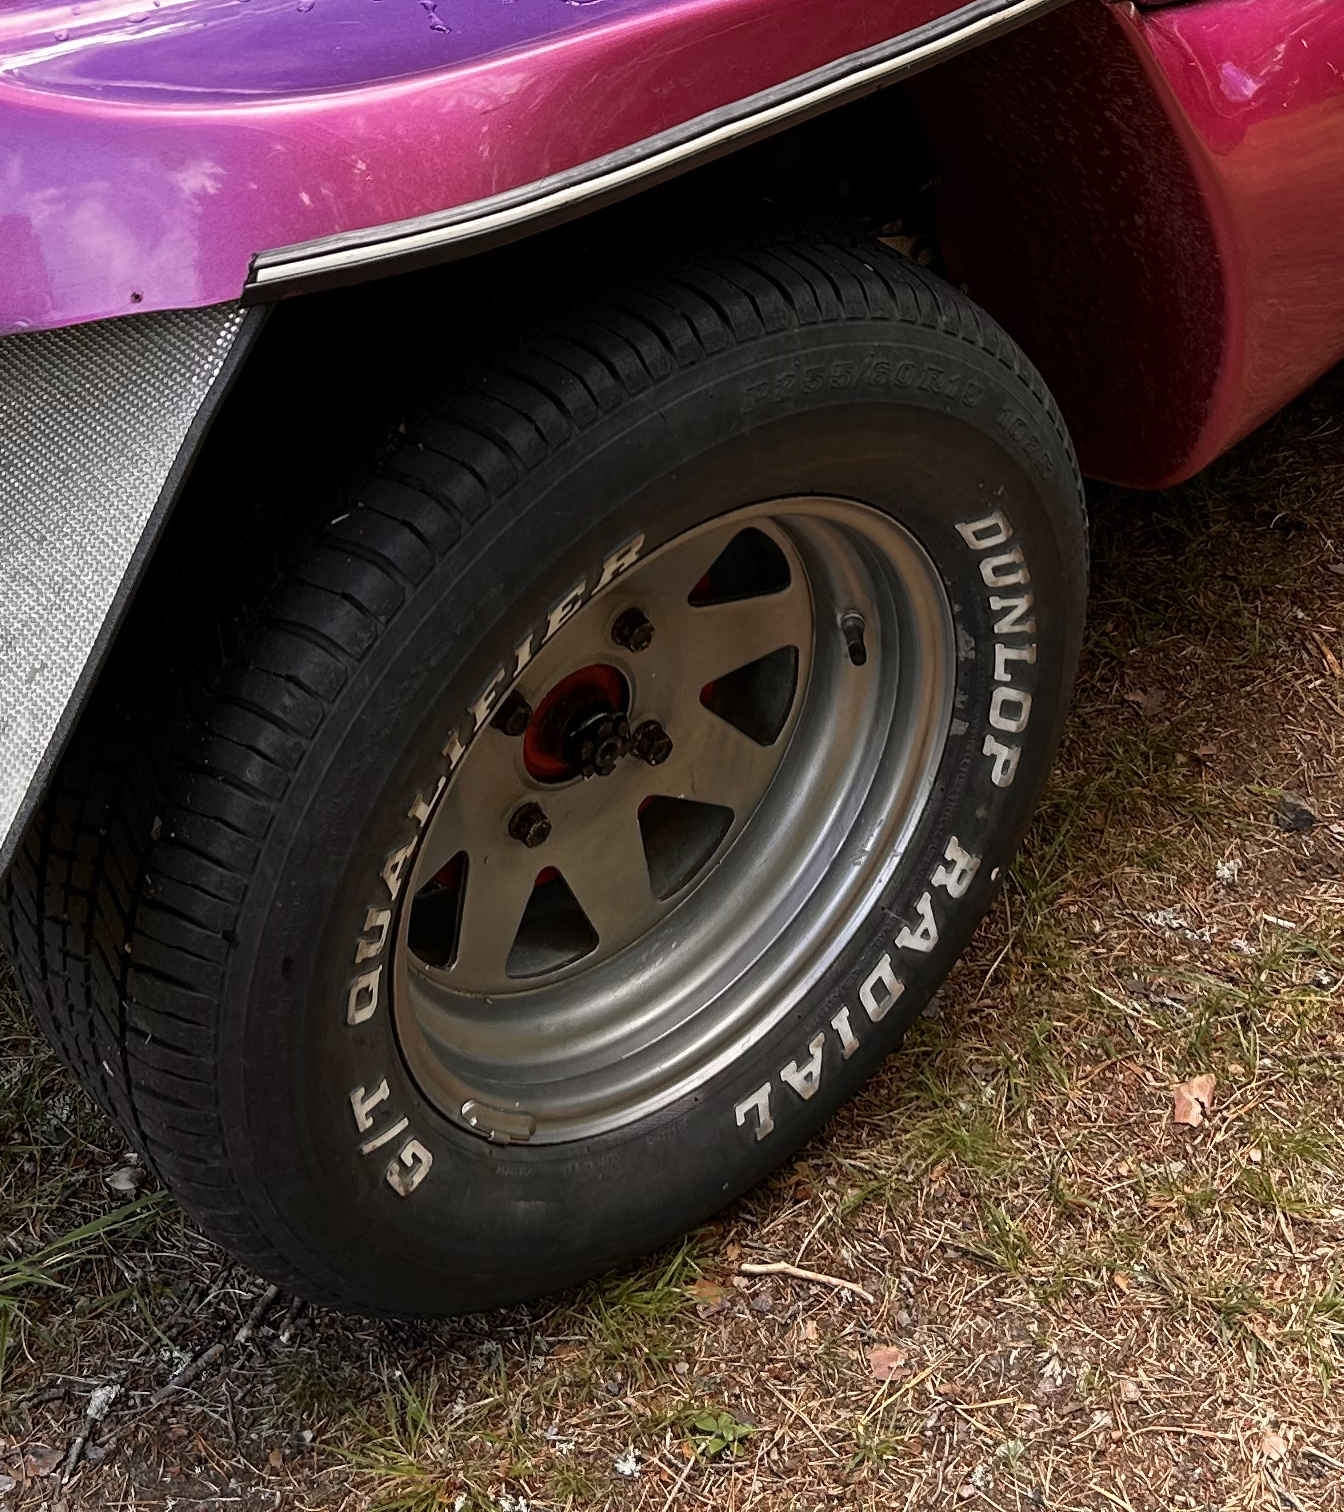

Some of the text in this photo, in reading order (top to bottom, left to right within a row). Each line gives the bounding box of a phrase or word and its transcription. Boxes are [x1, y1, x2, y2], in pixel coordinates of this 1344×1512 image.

[734, 510, 1038, 1142] DUNLOP RADIAL
[349, 1077, 434, 1198] G/T
